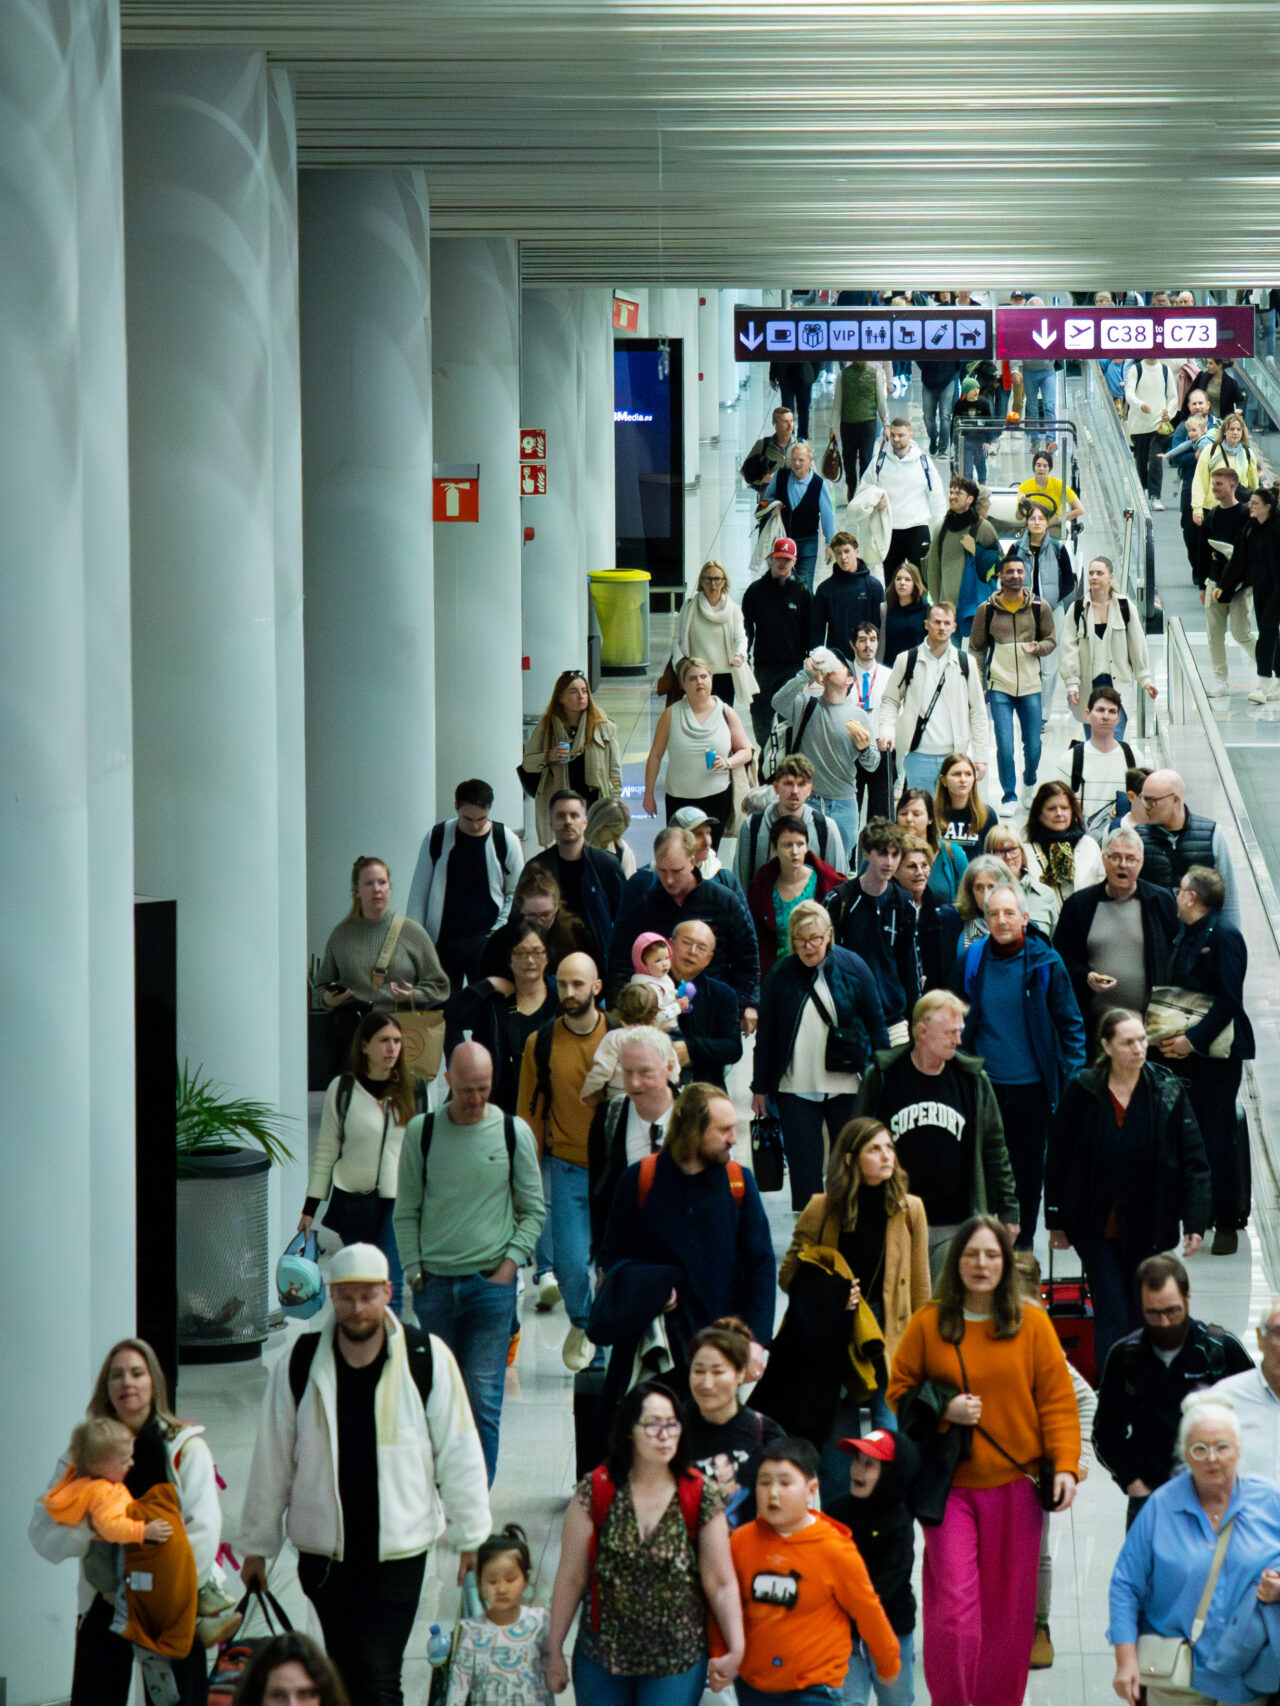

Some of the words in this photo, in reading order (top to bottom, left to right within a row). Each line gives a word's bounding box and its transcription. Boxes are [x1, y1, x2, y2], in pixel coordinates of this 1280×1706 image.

[833, 329, 856, 341] VIP
[1107, 325, 1146, 342] C38
[1155, 325, 1163, 333] to
[1171, 325, 1210, 342] C73
[890, 1101, 967, 1142] SUPERDRY
